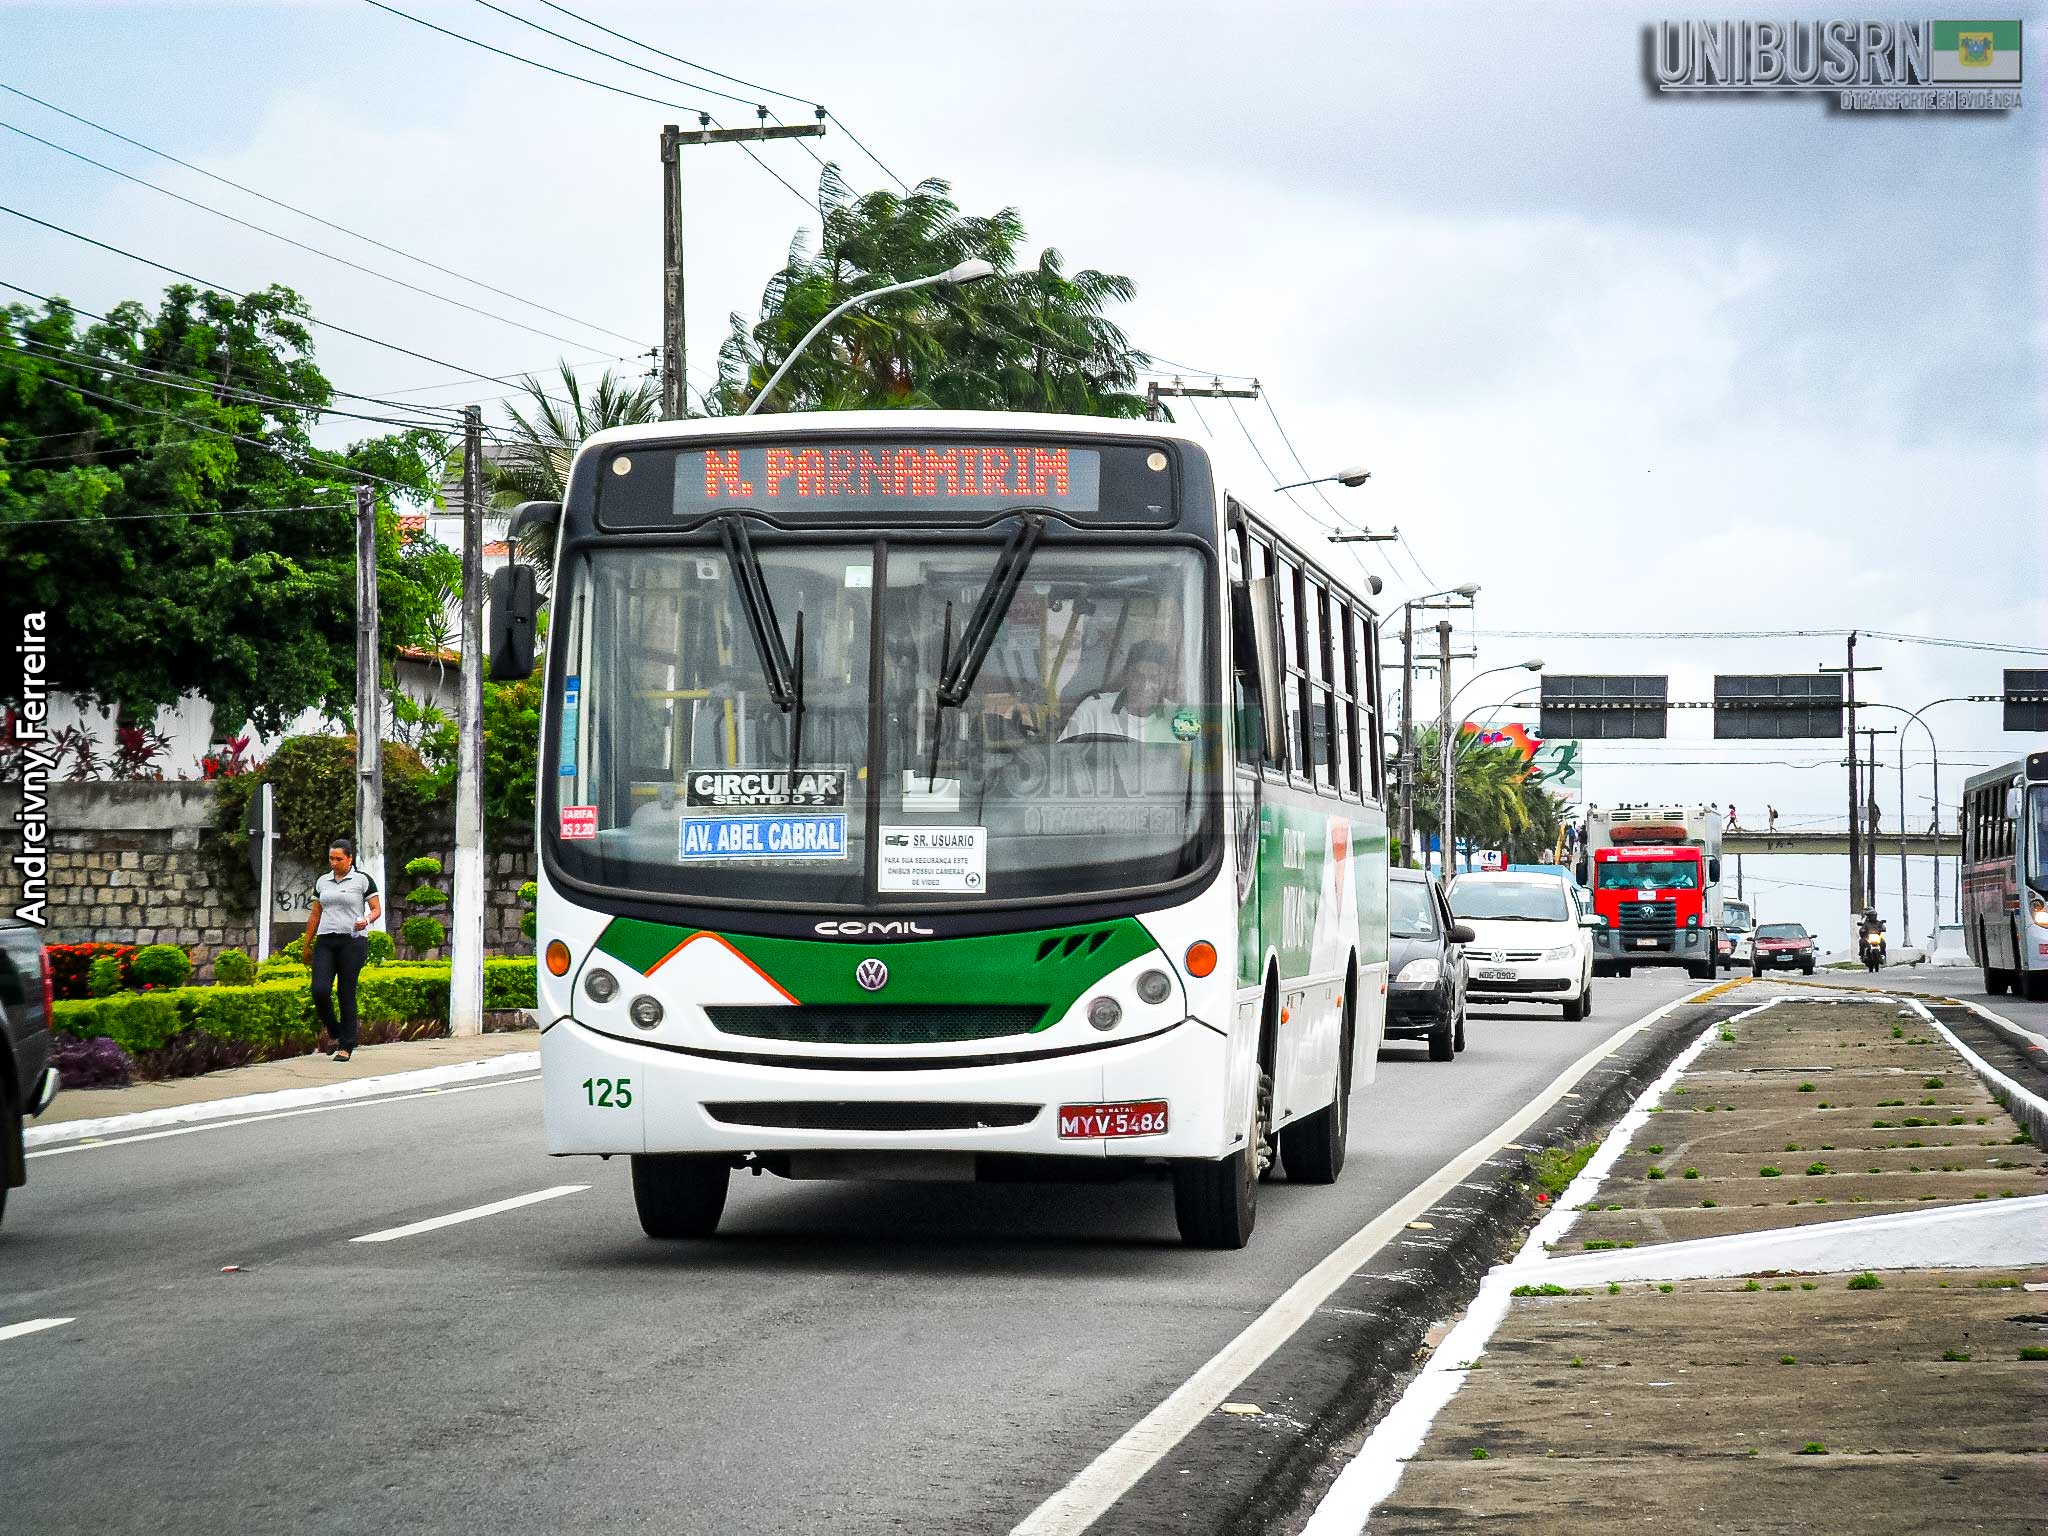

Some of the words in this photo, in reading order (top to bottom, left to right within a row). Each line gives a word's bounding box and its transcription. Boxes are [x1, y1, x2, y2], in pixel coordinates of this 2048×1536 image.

[705, 448, 753, 496] N.
[766, 447, 1069, 496] PARNAMIRIM
[694, 774, 837, 796] CIRCULAR
[712, 795, 806, 805] SENTIDO
[812, 795, 826, 804] 2
[562, 810, 594, 818] TARIFA
[685, 825, 713, 852] AV.
[717, 824, 765, 851] ABEL
[768, 822, 840, 850] CABRAL
[913, 834, 929, 847] SR.
[953, 857, 969, 865] ESTE
[814, 921, 934, 935] COMIL
[582, 1078, 633, 1109] 125
